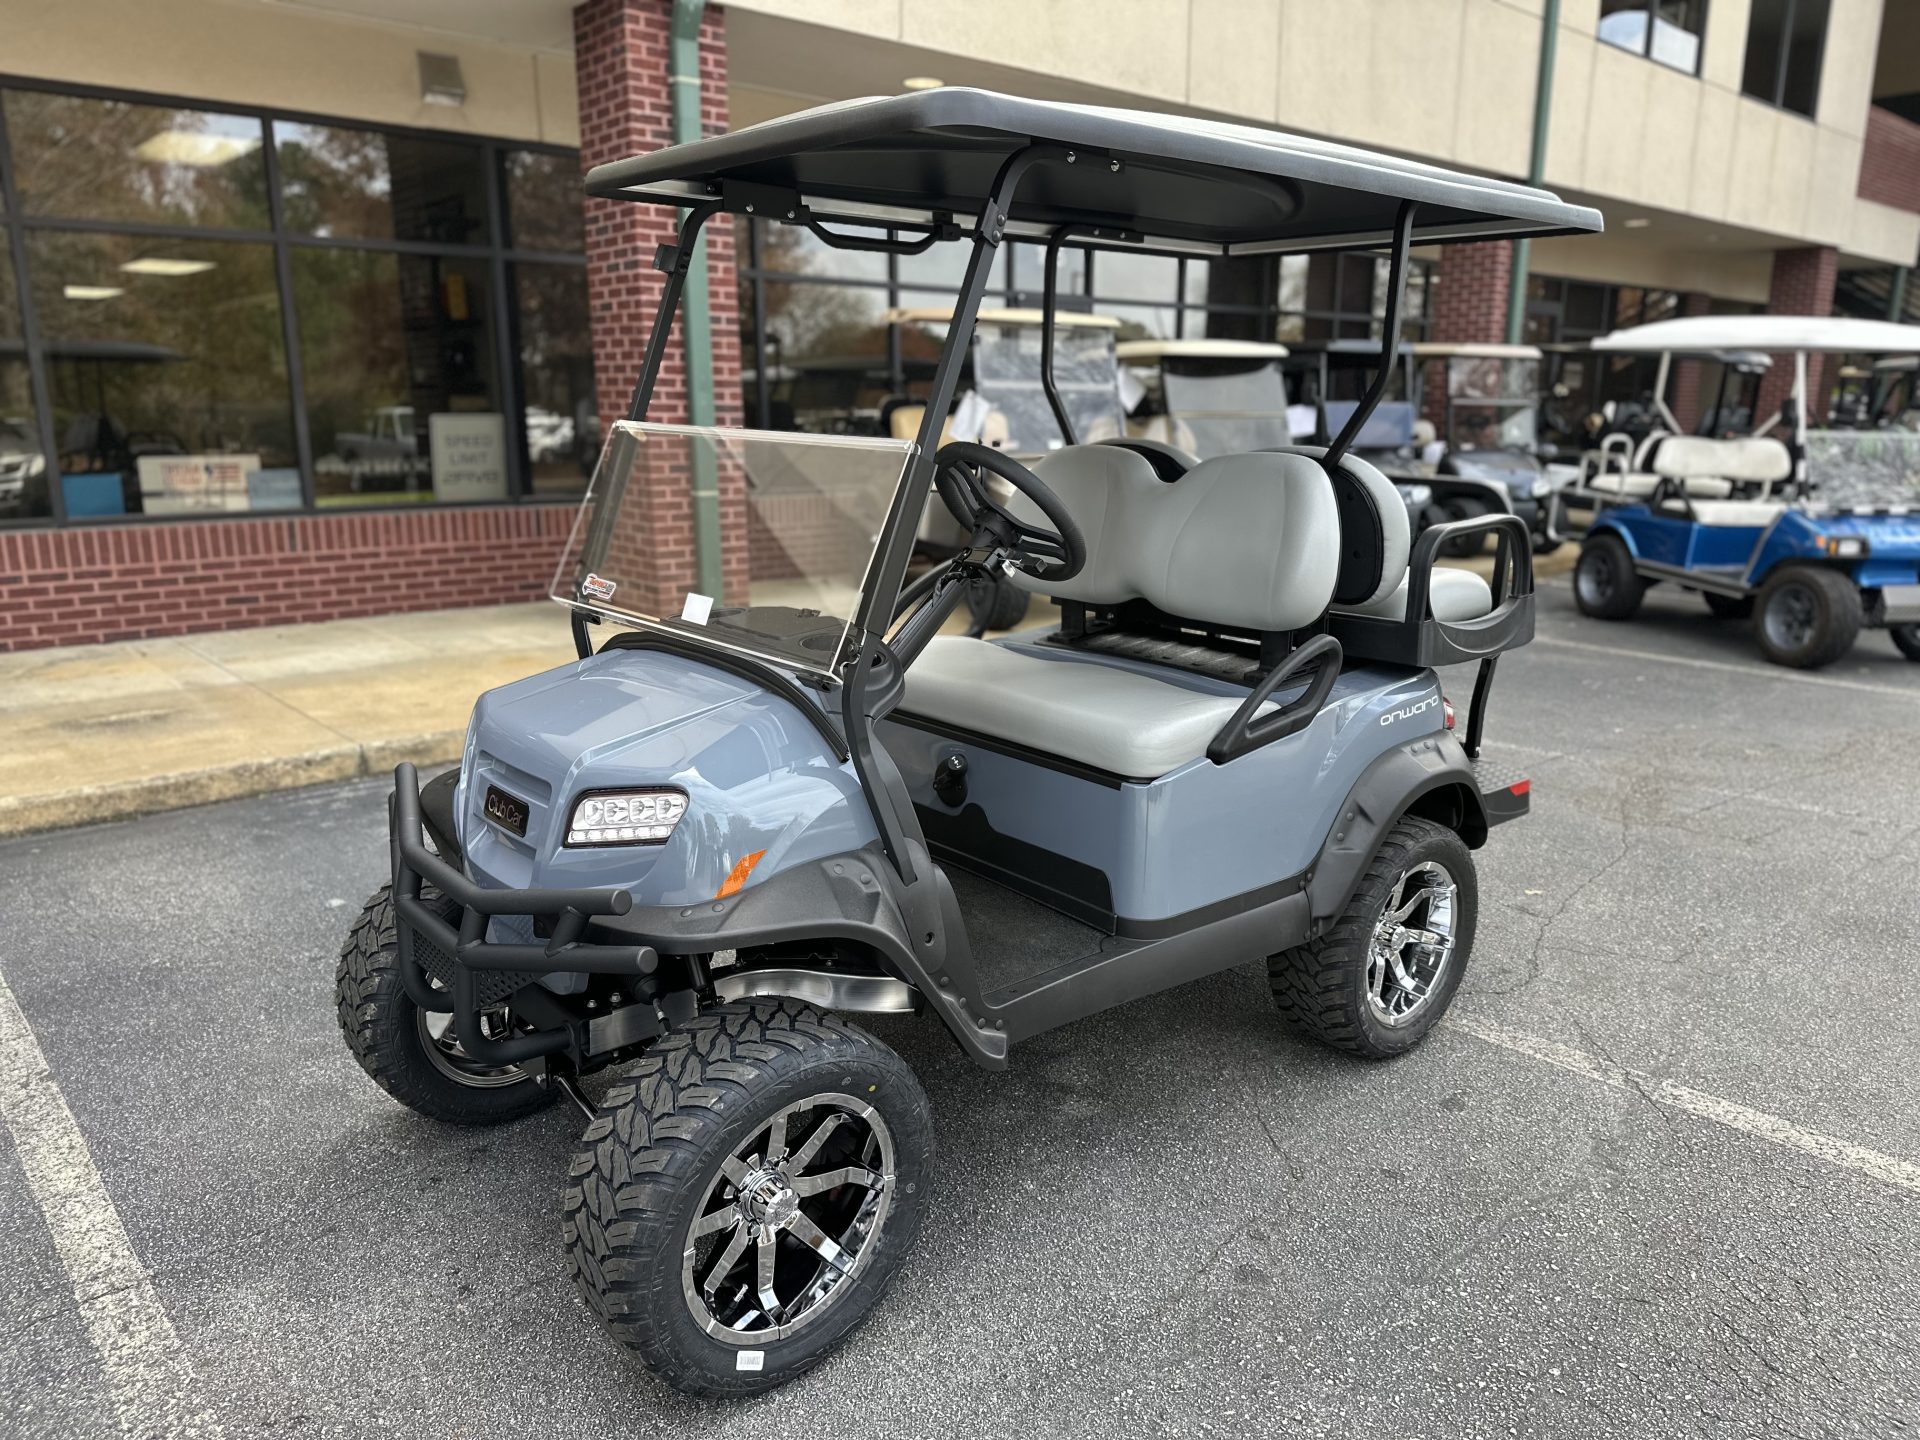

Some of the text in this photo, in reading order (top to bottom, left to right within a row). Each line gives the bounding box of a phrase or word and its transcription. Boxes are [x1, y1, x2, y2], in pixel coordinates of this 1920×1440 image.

[1380, 695, 1439, 726] onward
[488, 794, 524, 829] Club Car
